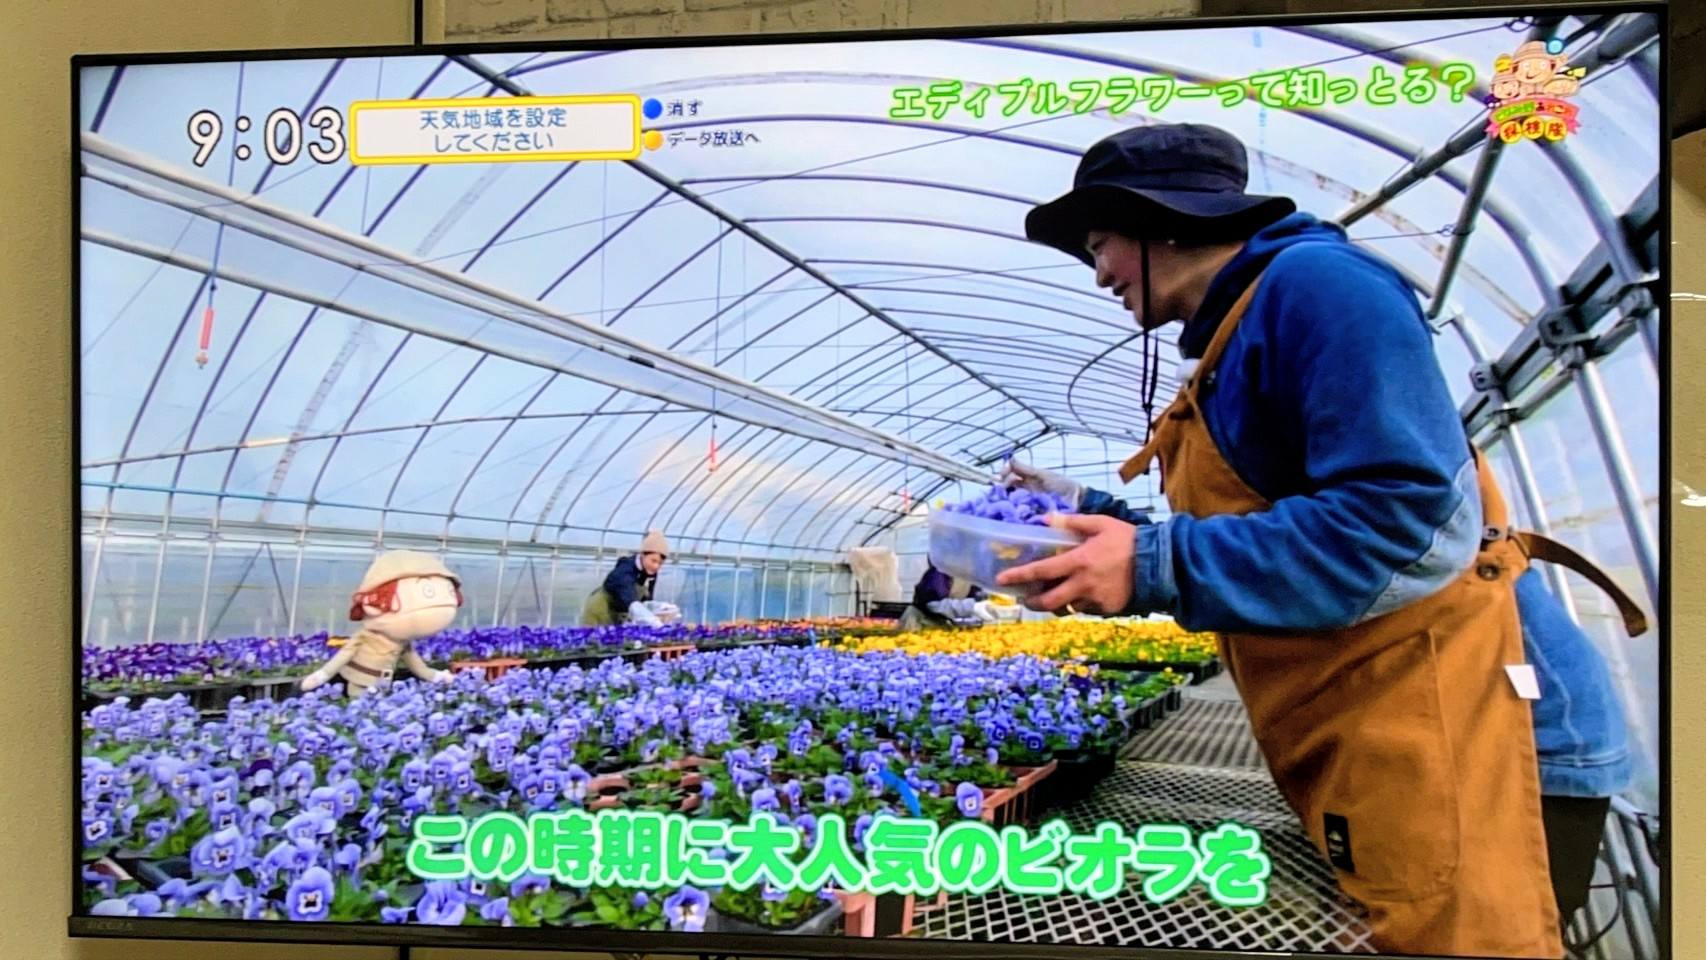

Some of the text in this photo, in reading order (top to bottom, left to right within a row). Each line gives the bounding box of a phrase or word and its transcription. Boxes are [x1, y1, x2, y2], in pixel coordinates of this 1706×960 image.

[420, 107, 567, 130] 天気地域を設定
[667, 100, 703, 117] 消す
[187, 107, 346, 167] 9:03
[433, 131, 554, 153] してください
[667, 130, 761, 148] データ放送へ
[408, 811, 1271, 908] この時期に大人気のビオラを
